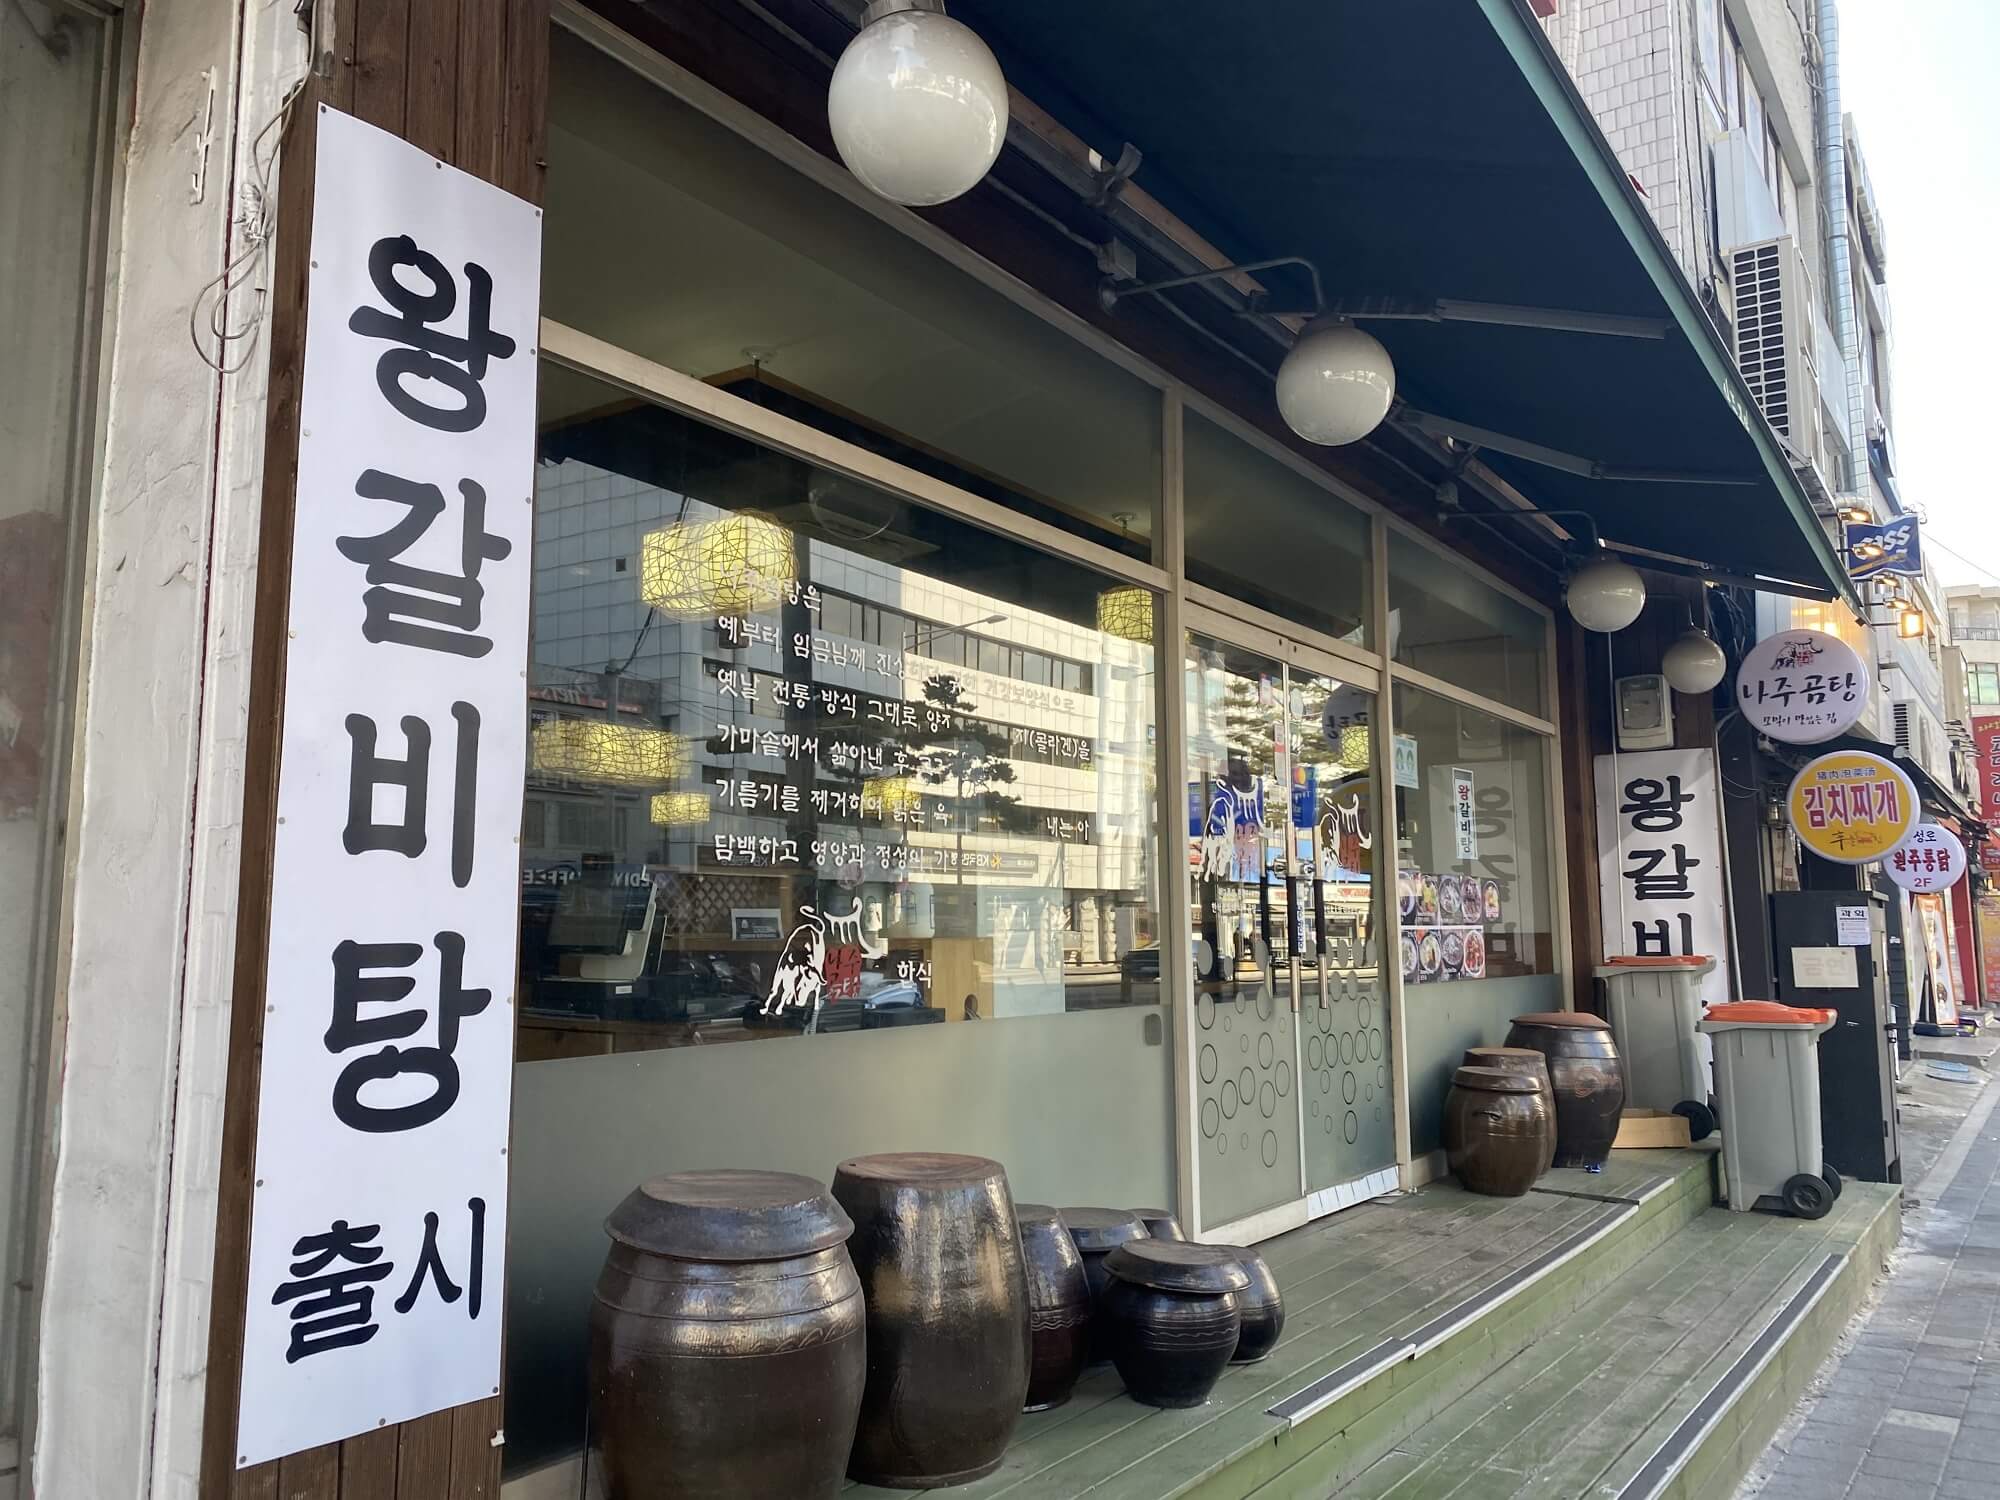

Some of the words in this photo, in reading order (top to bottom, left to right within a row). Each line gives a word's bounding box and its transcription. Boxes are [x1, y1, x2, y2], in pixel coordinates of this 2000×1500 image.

[718, 615, 780, 653] 예부터
[793, 632, 866, 673] 임금님께
[324, 234, 516, 1134] 왕갈비탕
[717, 668, 760, 703] 옛날
[772, 680, 811, 710] 전통
[821, 689, 857, 720] 방식
[867, 699, 918, 728] 그대로
[1743, 672, 1856, 707] 나주곰탕
[717, 724, 819, 764] 가마솥에서
[830, 742, 883, 771] 삶아낸
[893, 747, 910, 775] 후
[716, 779, 800, 813] 기름기를
[810, 789, 882, 822] 제거하여
[1457, 784, 1473, 853] 왕갈비탕
[1804, 781, 1899, 828] 김치찌개
[714, 834, 800, 865] 담백하고
[811, 840, 865, 869] 영양과
[1893, 849, 1950, 871] 원주통닭
[1913, 831, 1937, 843] 성로
[1914, 878, 1932, 888] 2F
[271, 1196, 487, 1365] 출시
